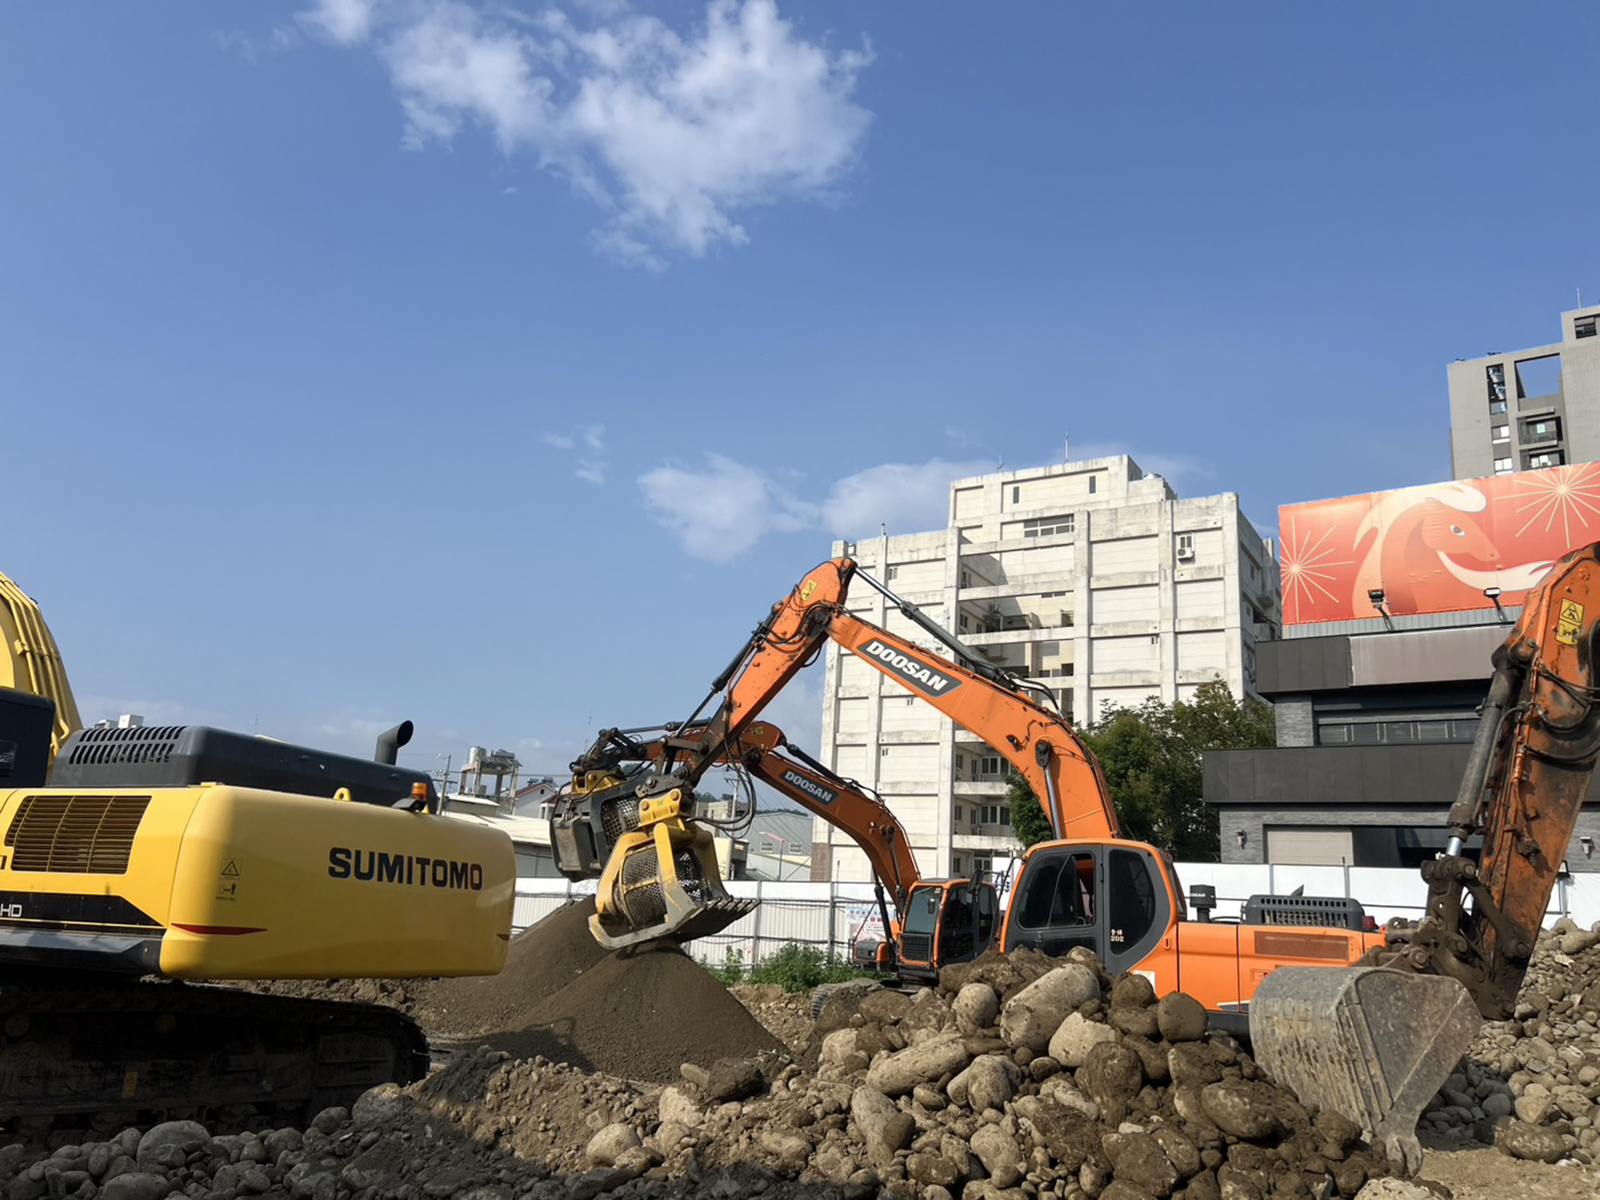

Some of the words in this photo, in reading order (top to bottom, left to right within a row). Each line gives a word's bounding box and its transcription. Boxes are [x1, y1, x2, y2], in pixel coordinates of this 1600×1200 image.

[866, 641, 948, 691] DOOSAN
[784, 770, 833, 802] DOOSAN
[328, 847, 483, 891] SUMITOMO
